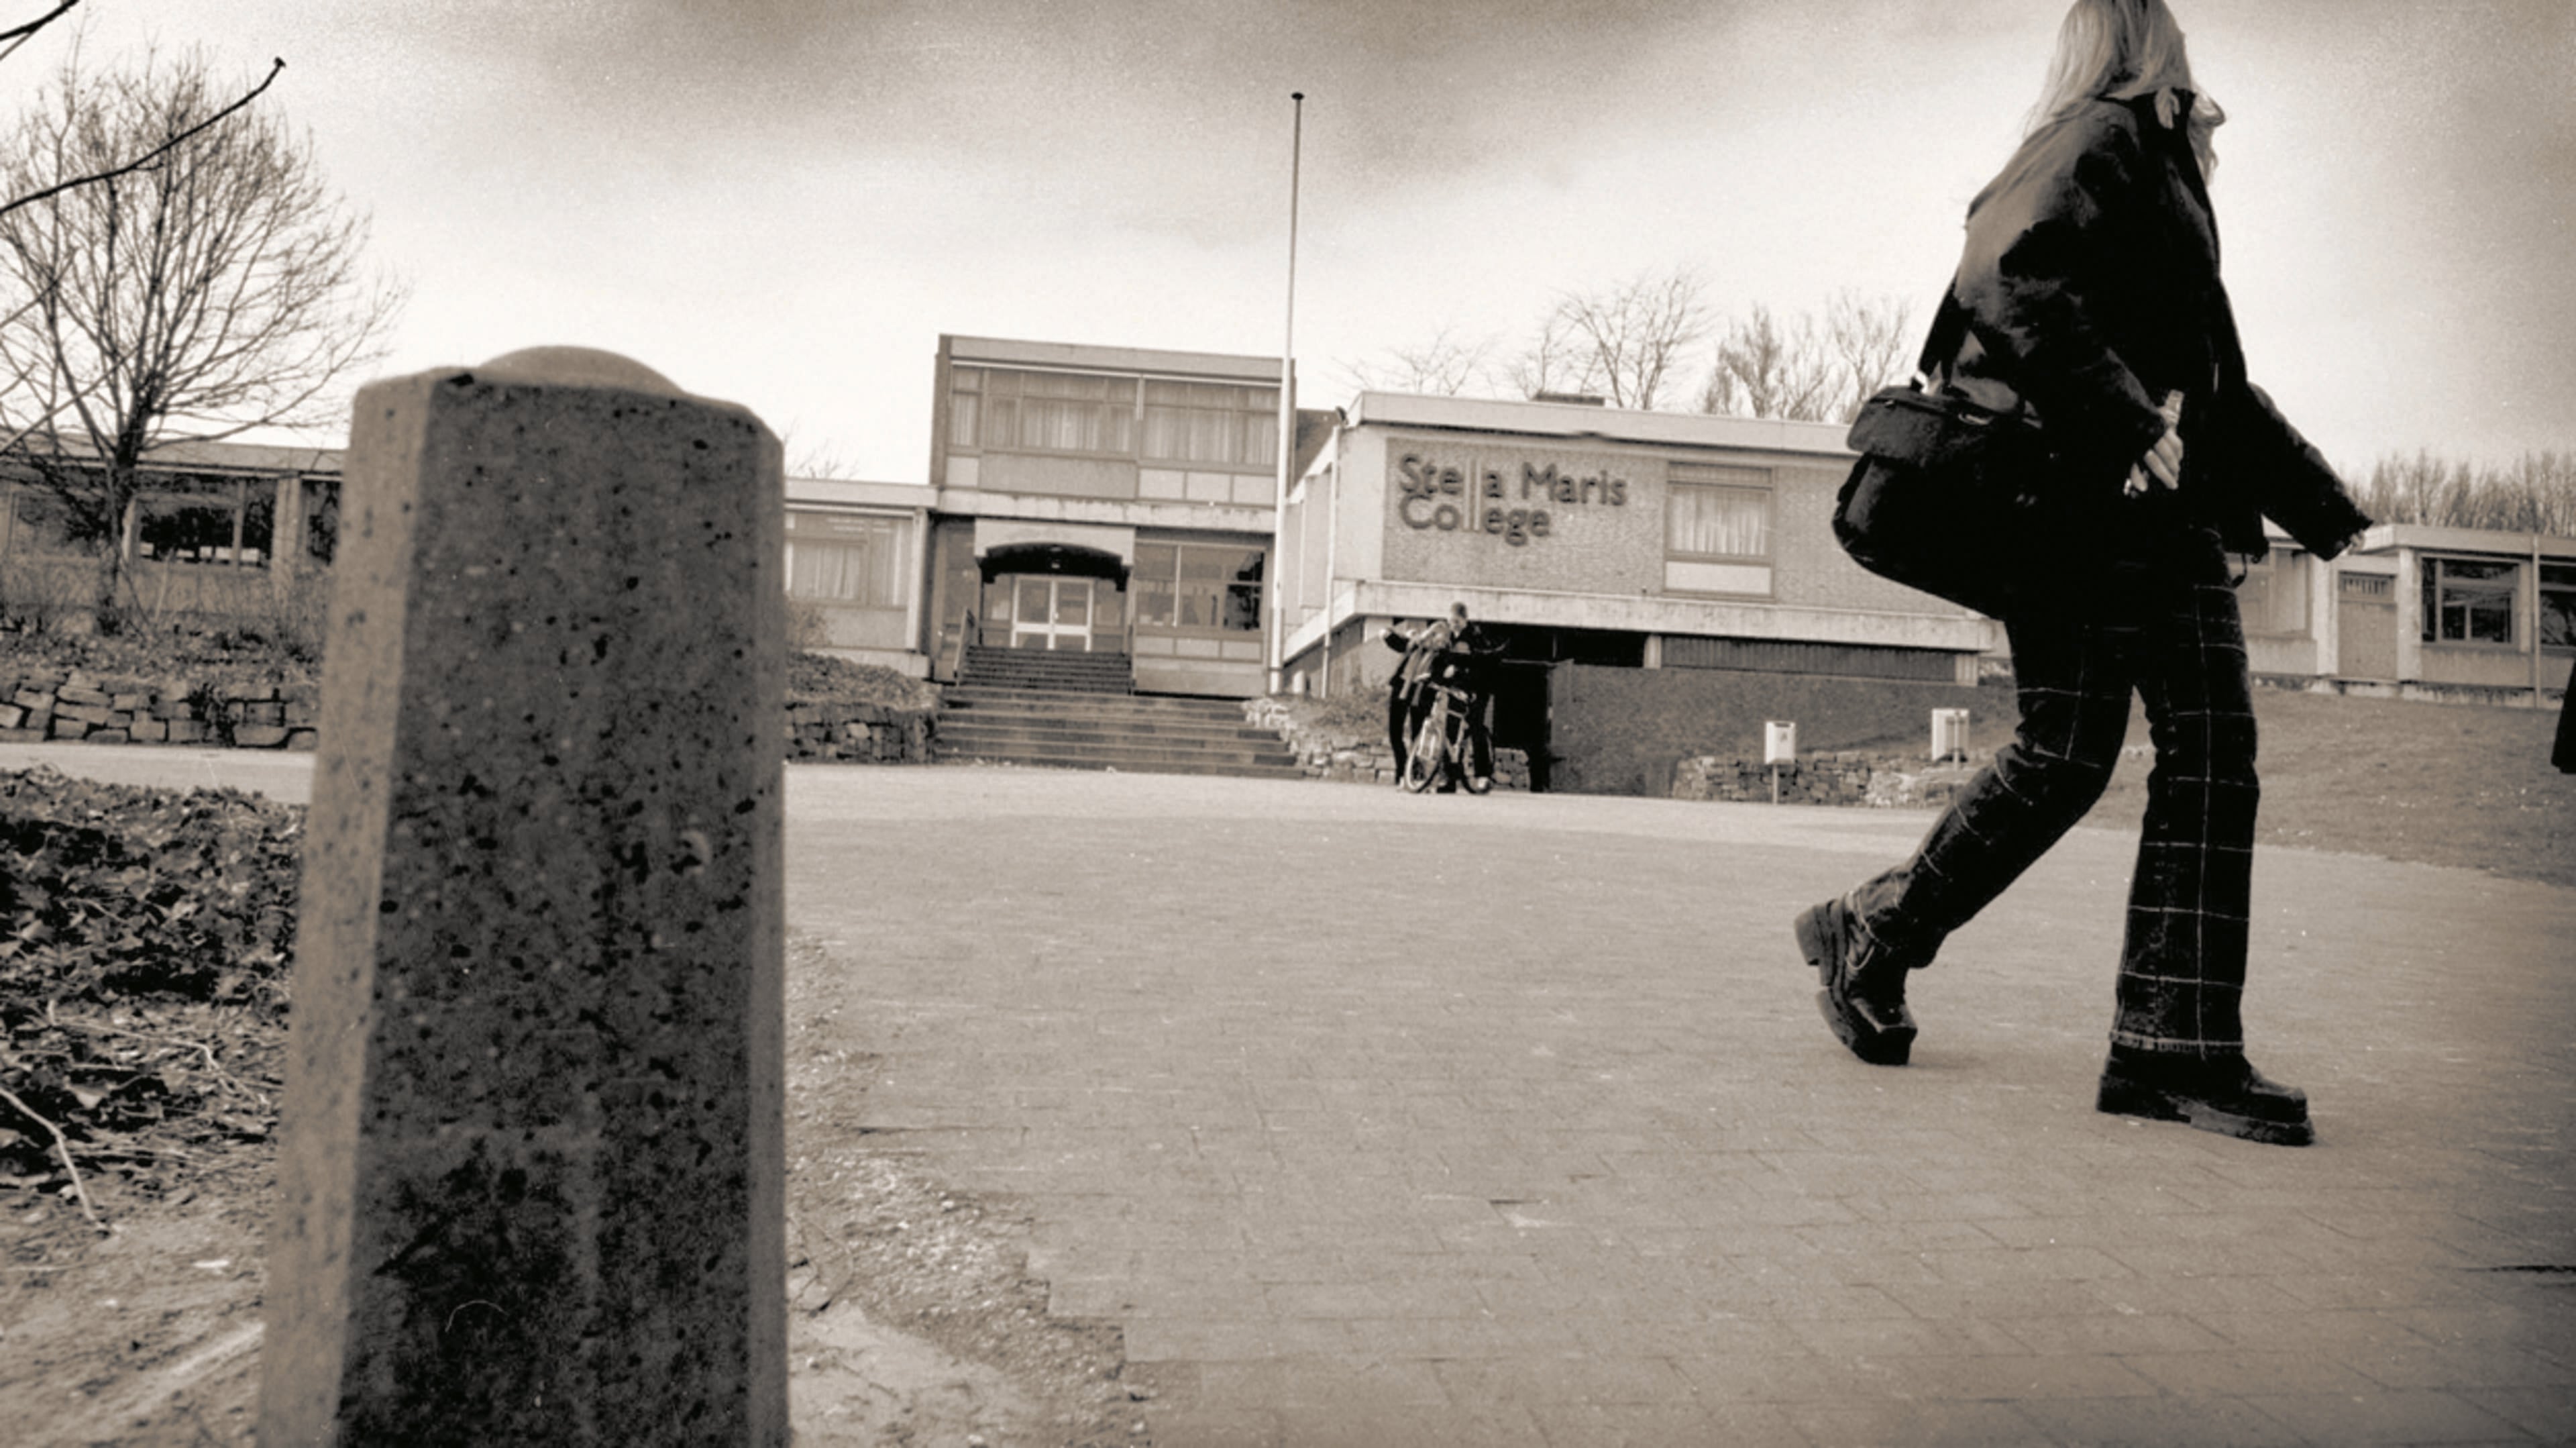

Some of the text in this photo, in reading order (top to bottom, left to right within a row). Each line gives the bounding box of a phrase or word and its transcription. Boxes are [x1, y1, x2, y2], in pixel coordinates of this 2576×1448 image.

[1399, 453, 1627, 506] Stella Maris
[1399, 493, 1550, 546] College
